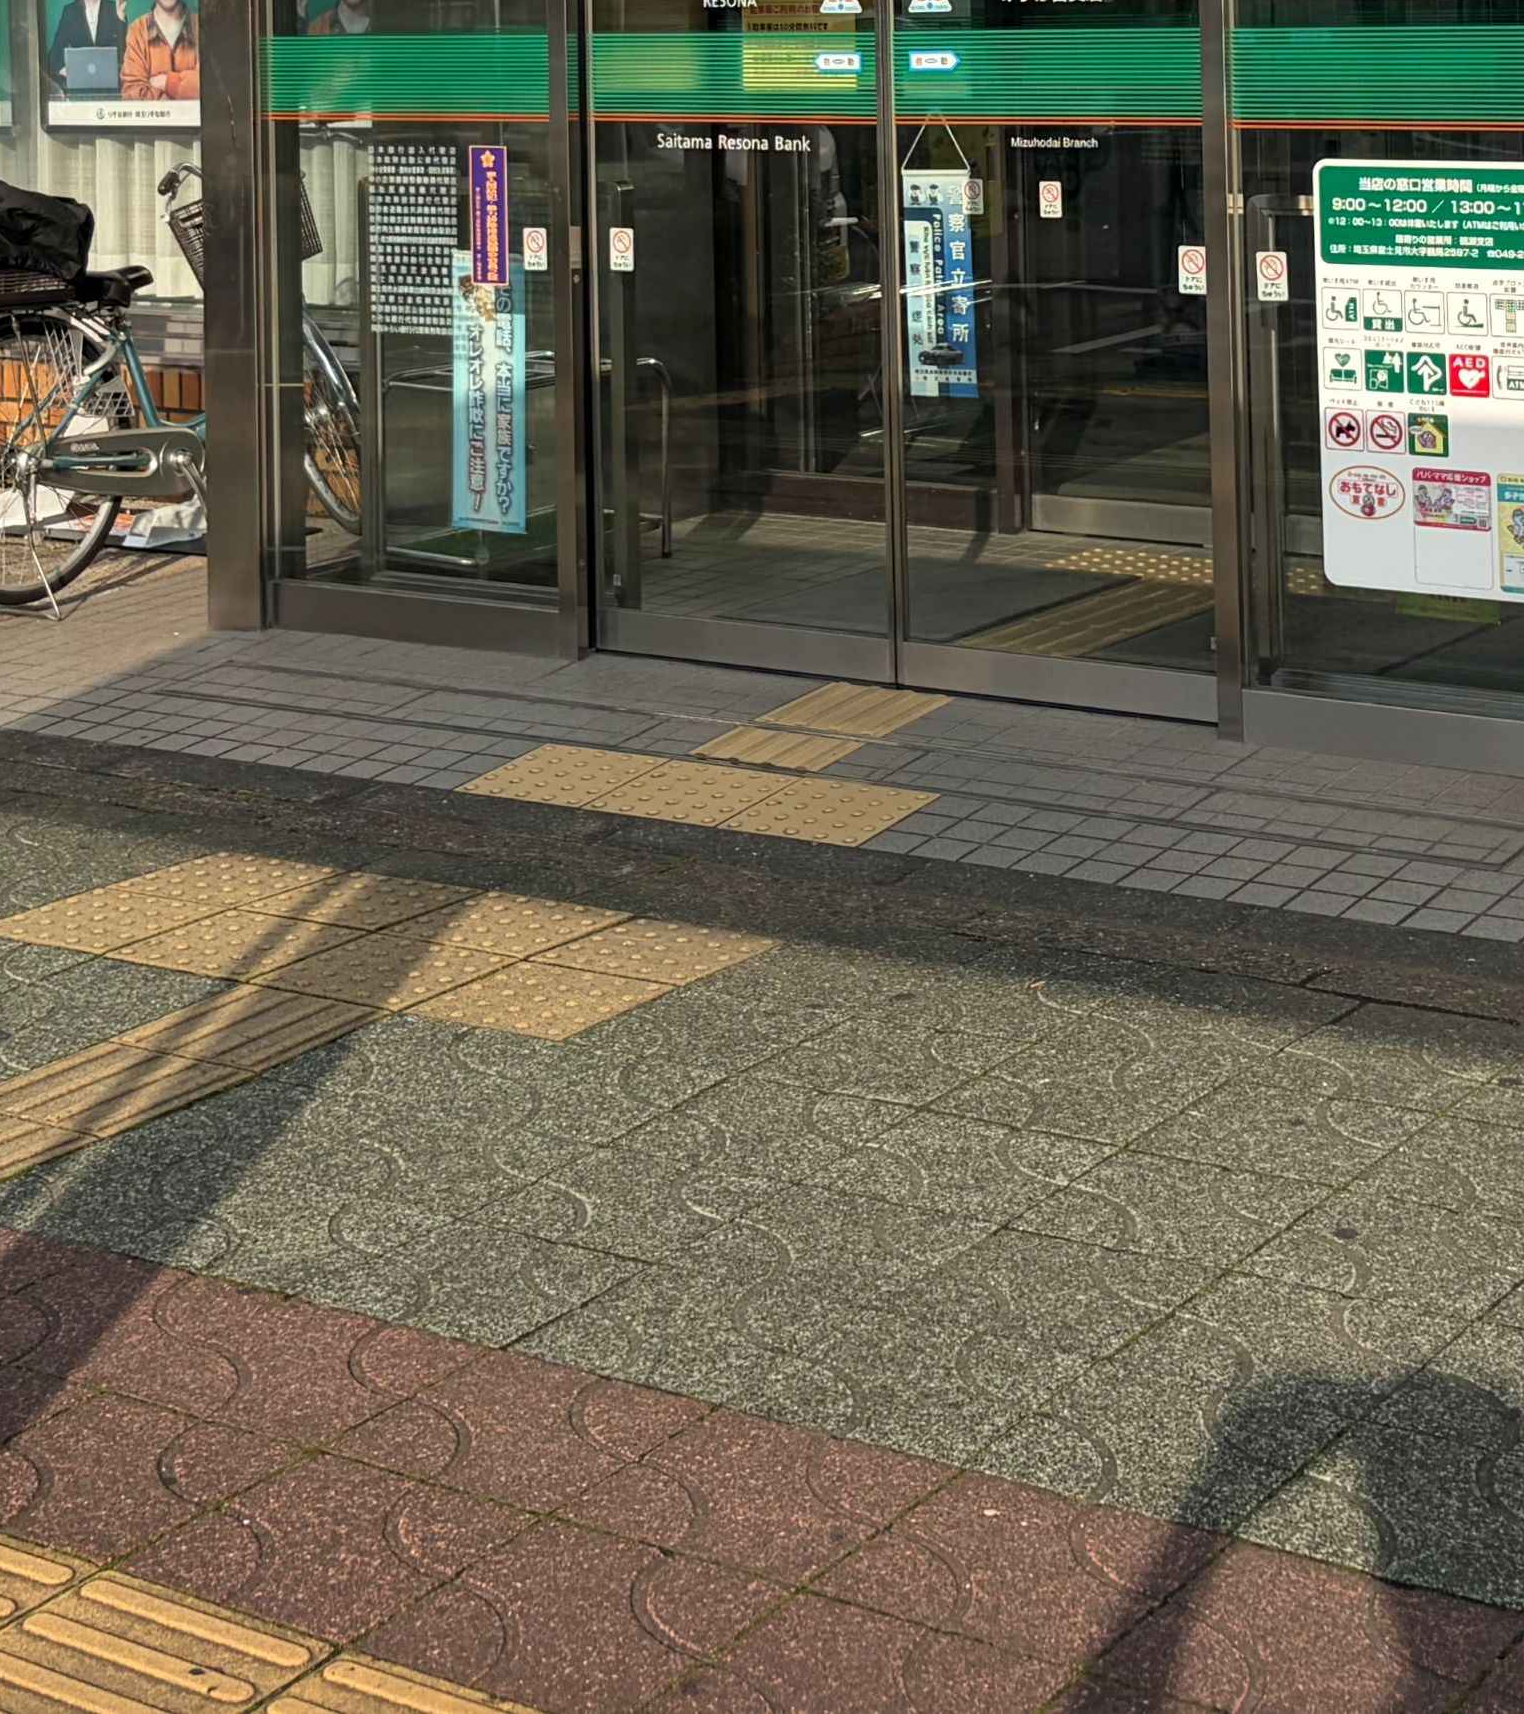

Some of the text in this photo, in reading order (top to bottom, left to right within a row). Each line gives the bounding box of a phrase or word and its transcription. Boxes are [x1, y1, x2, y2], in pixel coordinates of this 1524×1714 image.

[657, 133, 811, 151] Saitama Resona Bank
[1011, 136, 1099, 149] Mizuhodai Branch
[1359, 176, 1473, 193] 当店の窓口営業時間
[932, 213, 942, 253] Police
[937, 305, 946, 336] Area
[1453, 357, 1486, 368] AED
[1339, 480, 1397, 496] おもてなし
